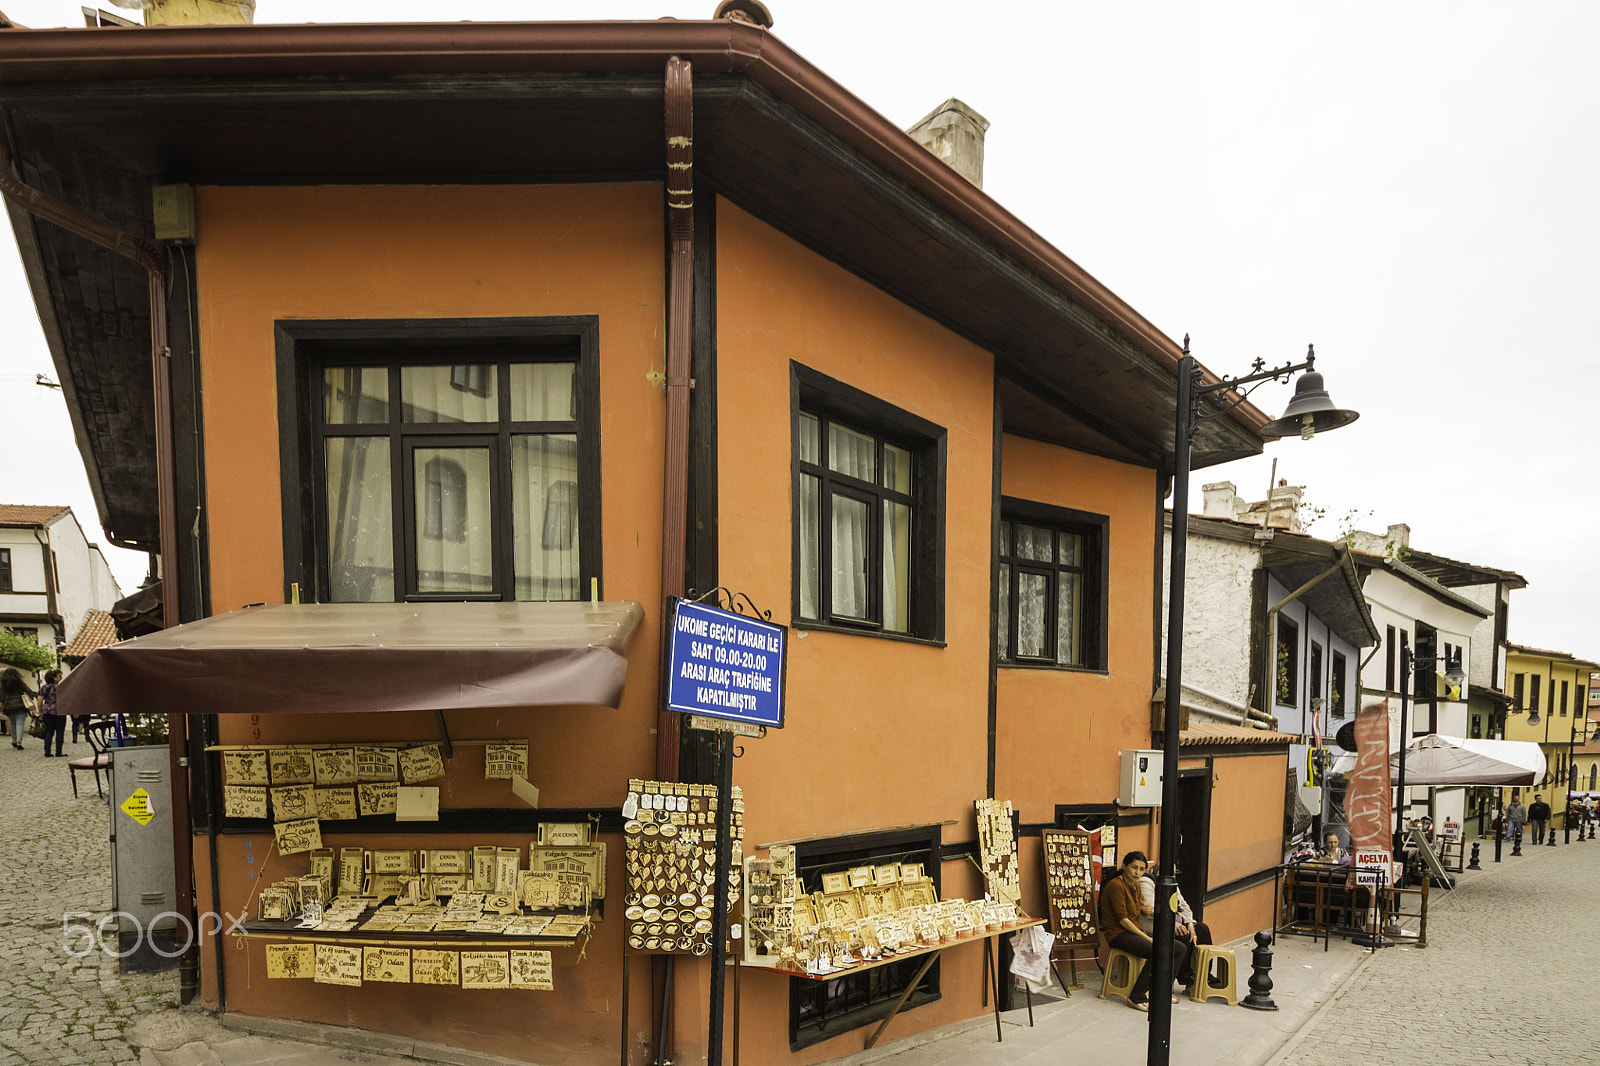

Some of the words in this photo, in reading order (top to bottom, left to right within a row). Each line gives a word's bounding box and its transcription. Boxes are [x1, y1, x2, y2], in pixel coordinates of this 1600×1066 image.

[678, 615, 708, 636] UKOME
[709, 623, 737, 645] GEÇİCİ
[738, 629, 765, 651] KARARI
[767, 633, 778, 653] İLE
[691, 641, 713, 660] SAAT
[714, 648, 766, 671] 09.00-20.00
[681, 661, 706, 682] ARASI
[708, 667, 730, 689] ARAÇ
[732, 671, 772, 692] TRAFİĞİNE
[697, 687, 757, 712] KAPATILMIŞTIR
[1358, 854, 1388, 864] AÇELYA
